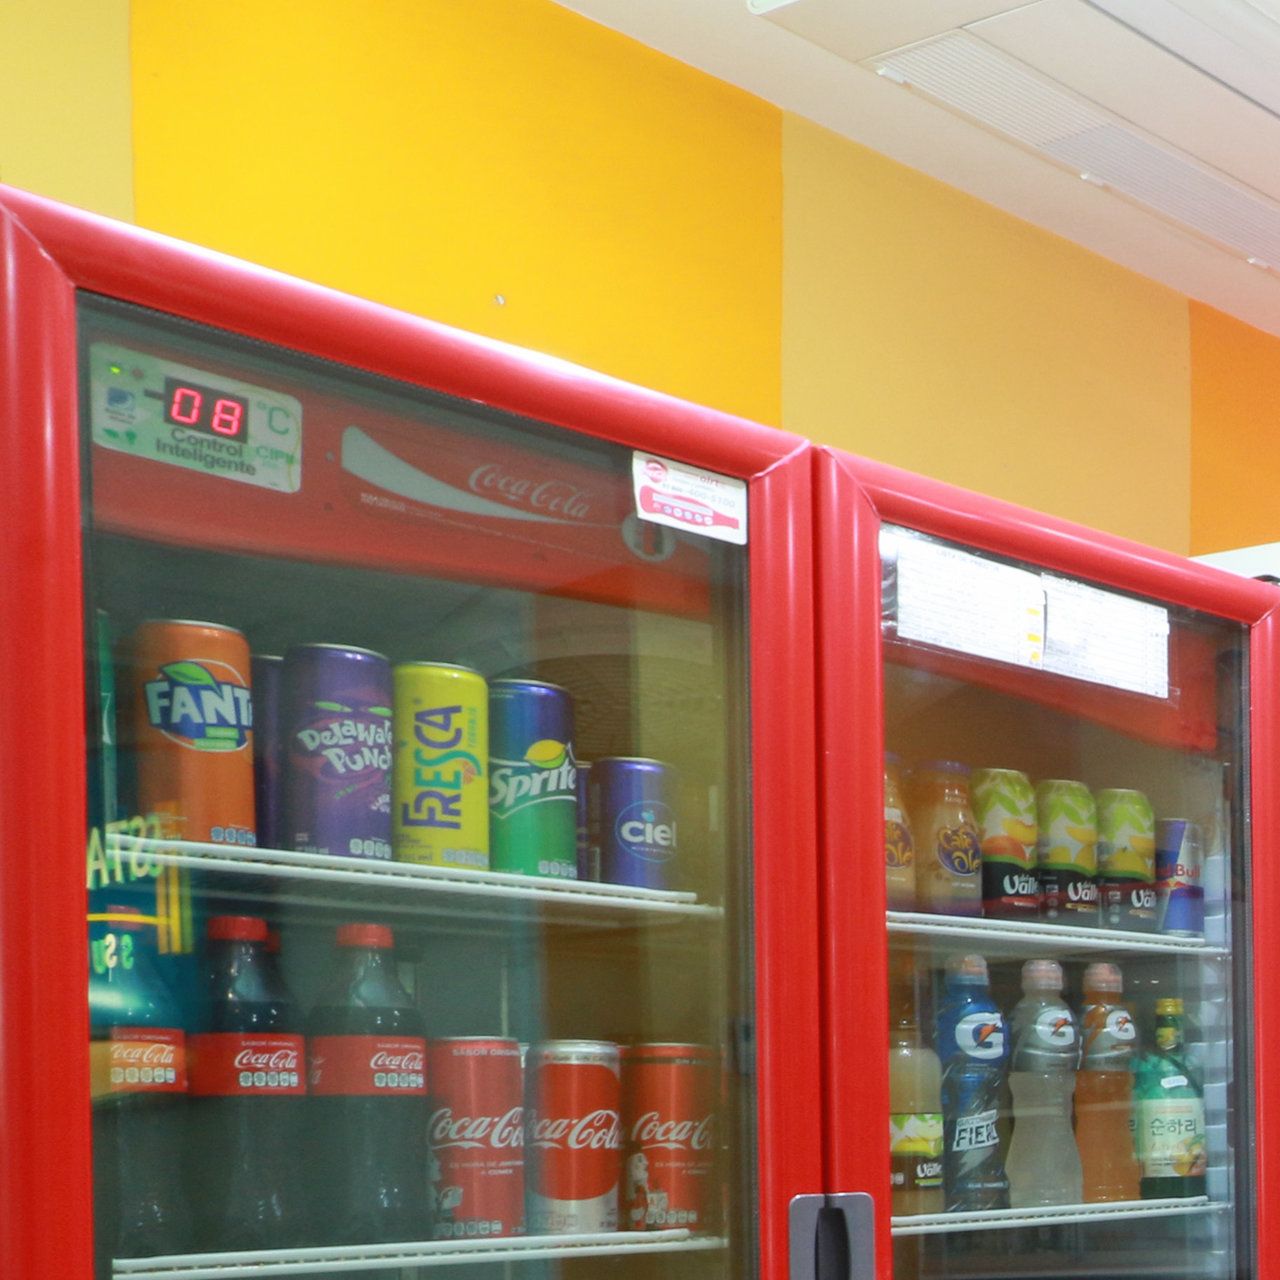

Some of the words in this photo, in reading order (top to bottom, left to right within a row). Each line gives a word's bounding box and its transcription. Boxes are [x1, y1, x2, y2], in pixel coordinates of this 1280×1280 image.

[170, 387, 243, 436] 08
[155, 438, 257, 477] Inteligente
[171, 427, 244, 458] Control
[145, 680, 253, 726] FANT
[402, 705, 472, 830] FRESCA
[490, 750, 577, 806] Sprite
[620, 816, 677, 848] ciel
[111, 1043, 175, 1065] Coca-Cola
[234, 1049, 297, 1070] Coca-Cola
[370, 1051, 424, 1071] Coca-Cola
[1150, 1116, 1198, 1137] 순하리
